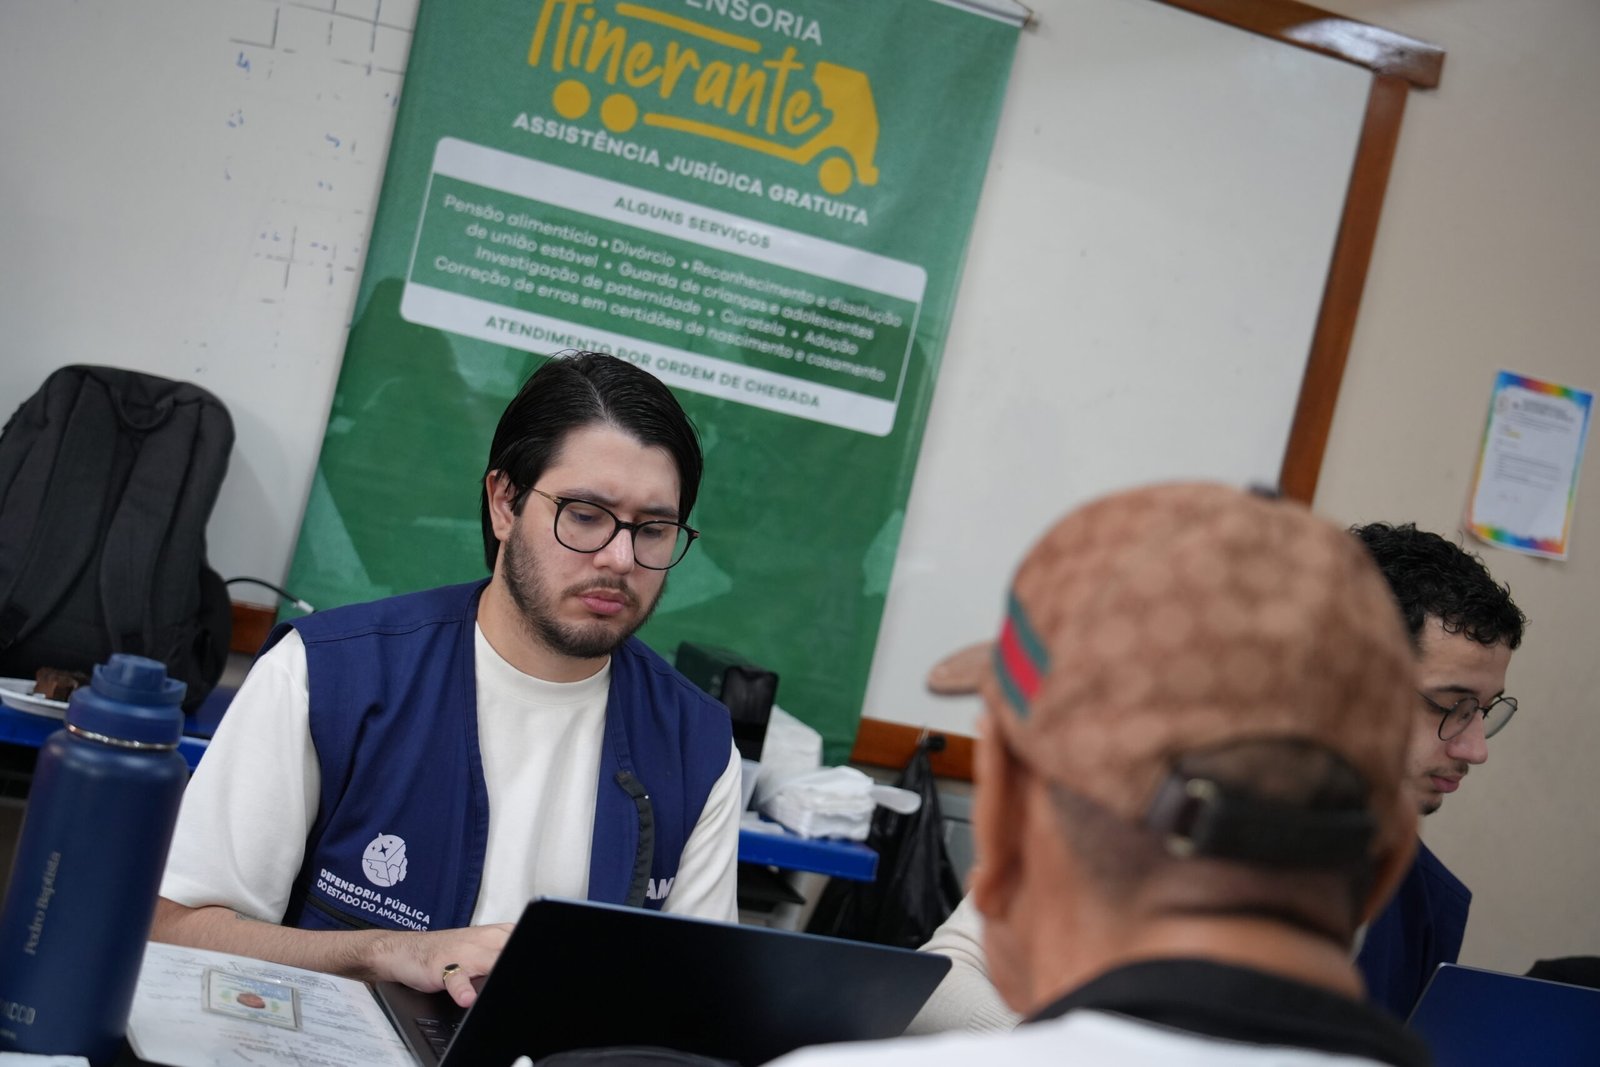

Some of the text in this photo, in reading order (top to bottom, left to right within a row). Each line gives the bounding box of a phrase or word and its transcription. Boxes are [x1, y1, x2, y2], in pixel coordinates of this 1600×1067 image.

[512, 112, 869, 226] ASSISTÊNCIA JURÍDICA GRATUITA
[614, 196, 771, 250] ALGUNS SERVIÇOS
[443, 194, 505, 223] Pensão
[506, 213, 599, 248] alimentícia
[611, 238, 676, 268] Divórcio
[691, 259, 815, 305] Reconhecimento
[465, 223, 488, 240] de
[490, 231, 538, 252] união
[540, 243, 599, 268] estável
[618, 261, 678, 289] Guarda
[679, 278, 701, 295] de
[702, 284, 768, 313] crianças
[781, 306, 875, 341] adolescentes
[475, 245, 859, 356] Investigação de paternidade Curatela Adoção
[434, 255, 511, 288] Correção
[513, 278, 535, 294] de
[537, 284, 579, 305] erros
[580, 296, 607, 313] em
[609, 301, 683, 332] certidões
[684, 321, 706, 337] de
[806, 352, 886, 383] casamento
[485, 315, 820, 408] ATENDIMENTO POR ORDEM DE CHEGADA
[316, 878, 428, 932] DO ESTADO DO AMAZONAS
[320, 868, 430, 924] DEFENSORIA PÚBLICA
